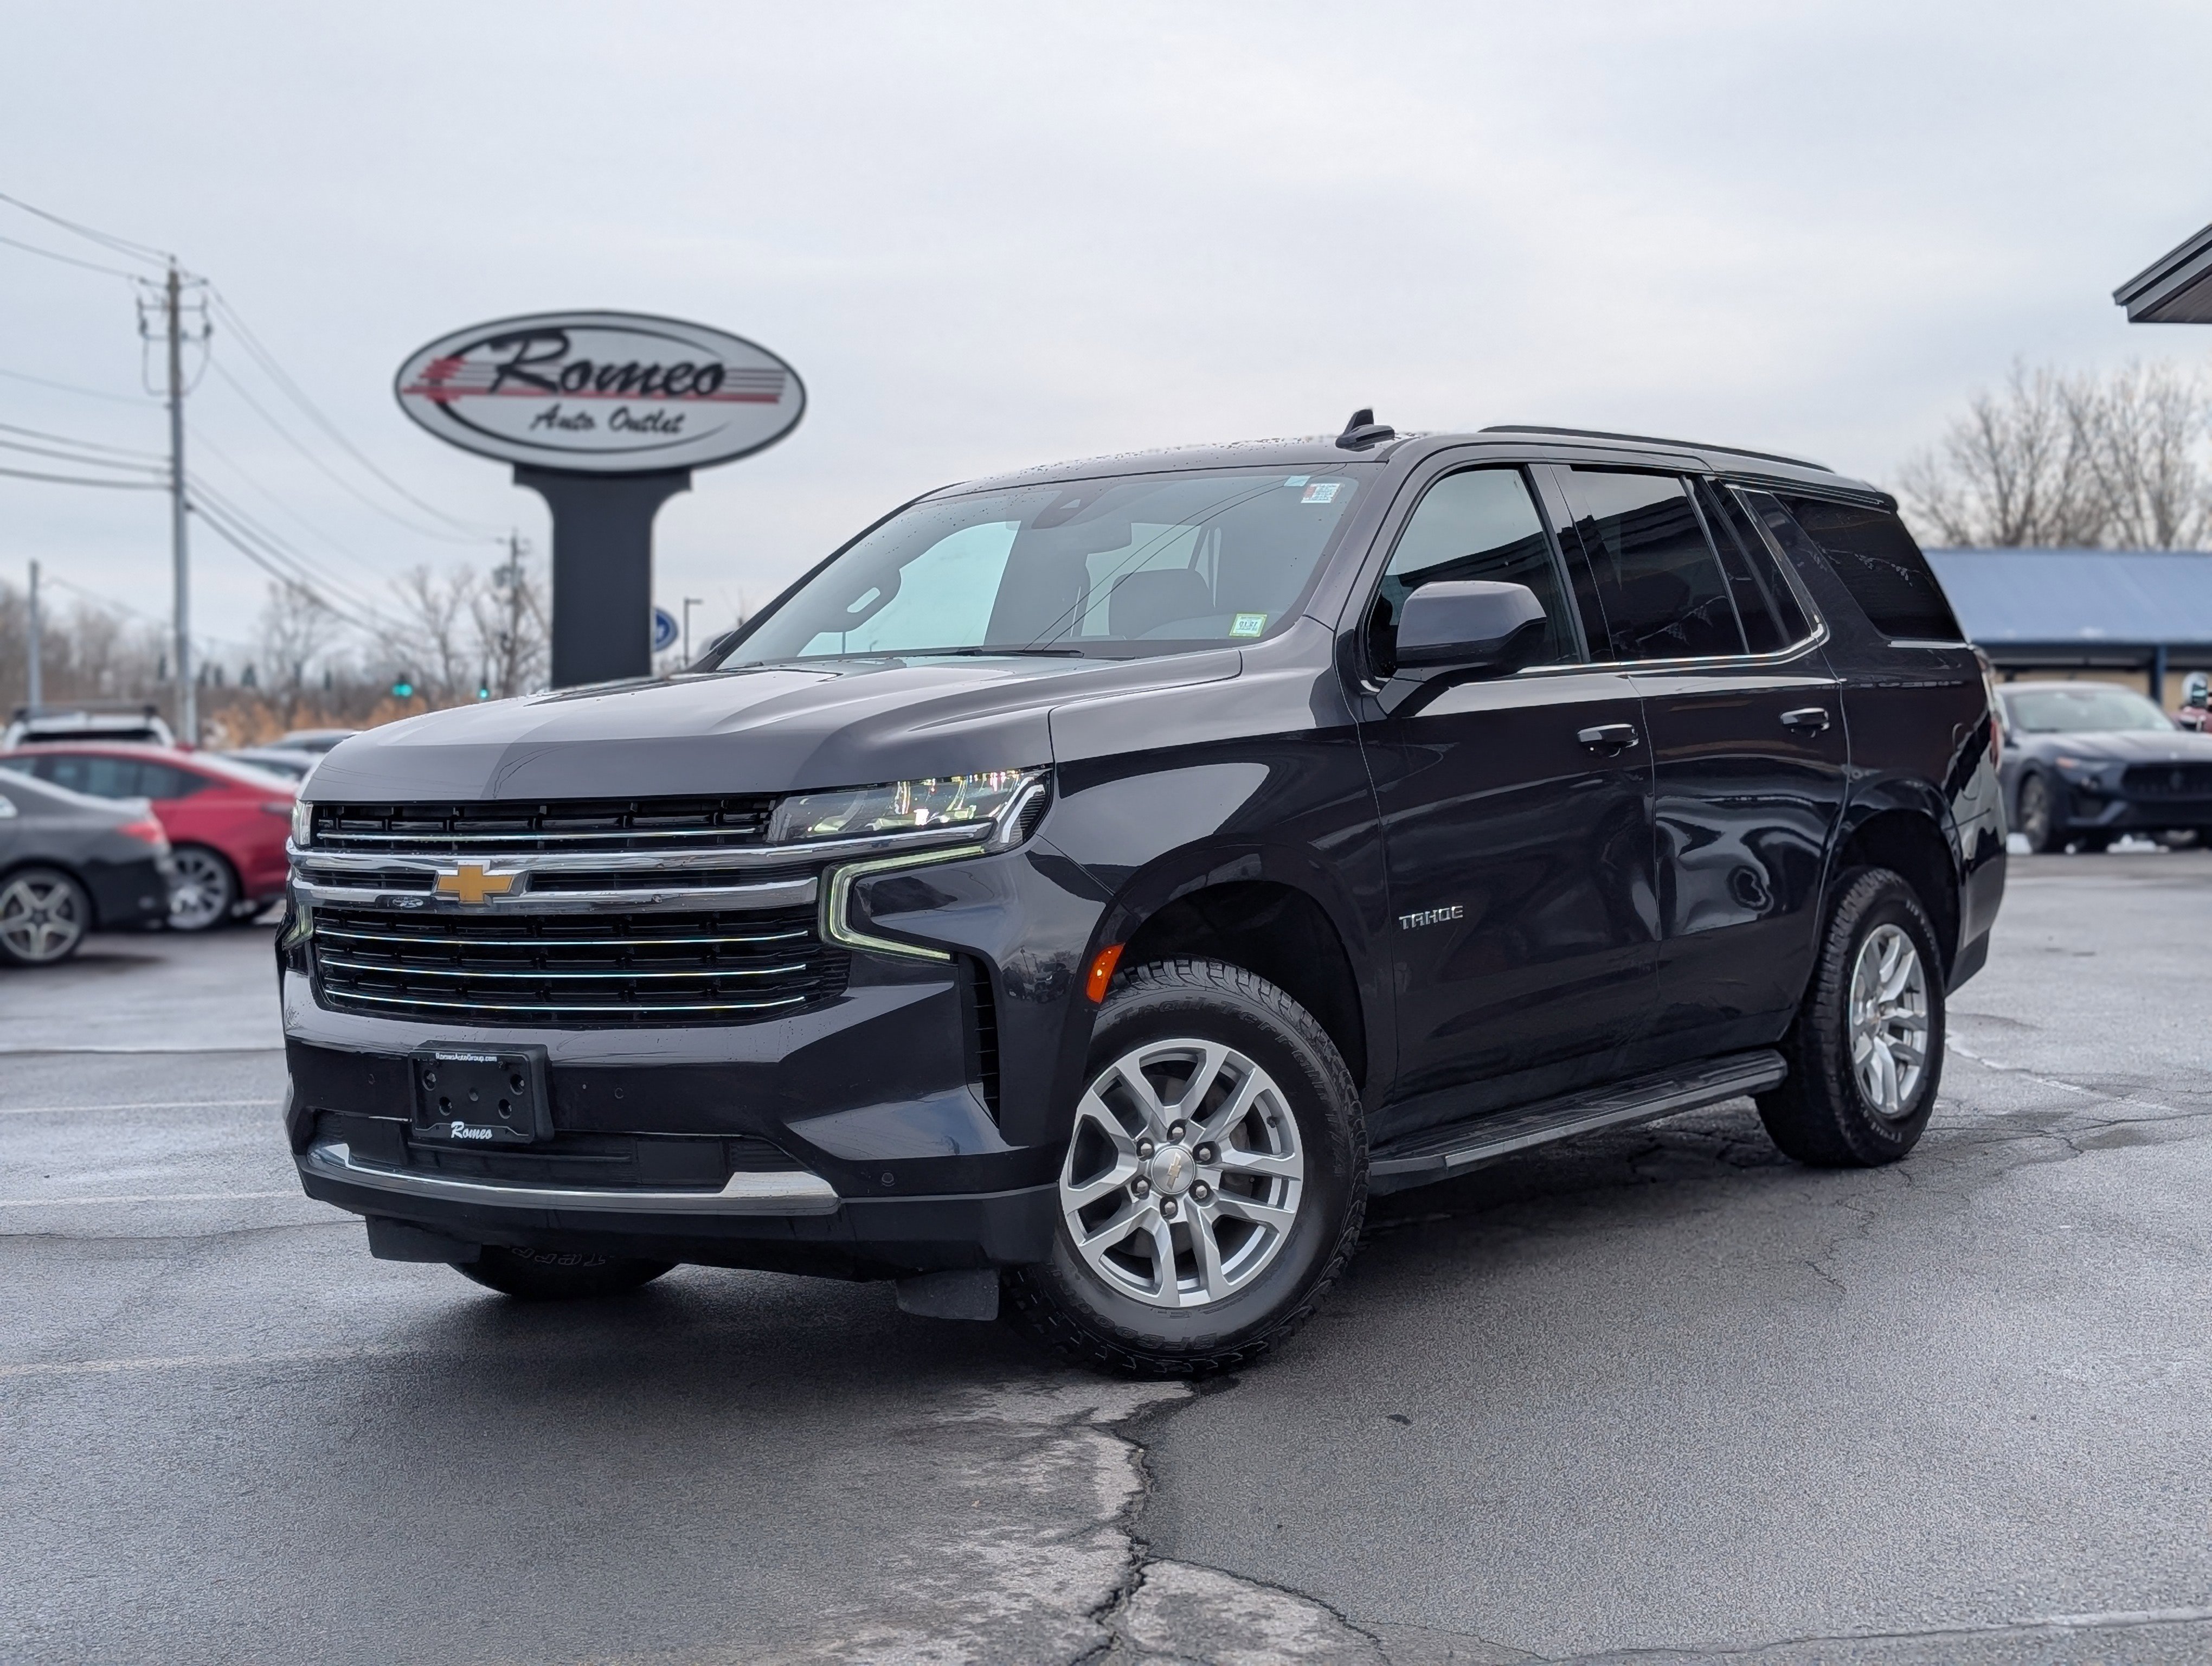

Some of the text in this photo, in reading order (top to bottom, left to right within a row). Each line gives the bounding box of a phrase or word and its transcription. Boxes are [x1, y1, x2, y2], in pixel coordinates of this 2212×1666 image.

[487, 329, 726, 396] Romeo
[530, 403, 686, 435] Auto Outlet
[1399, 906, 1463, 930] TAHOE
[451, 1121, 493, 1139] Romeo
